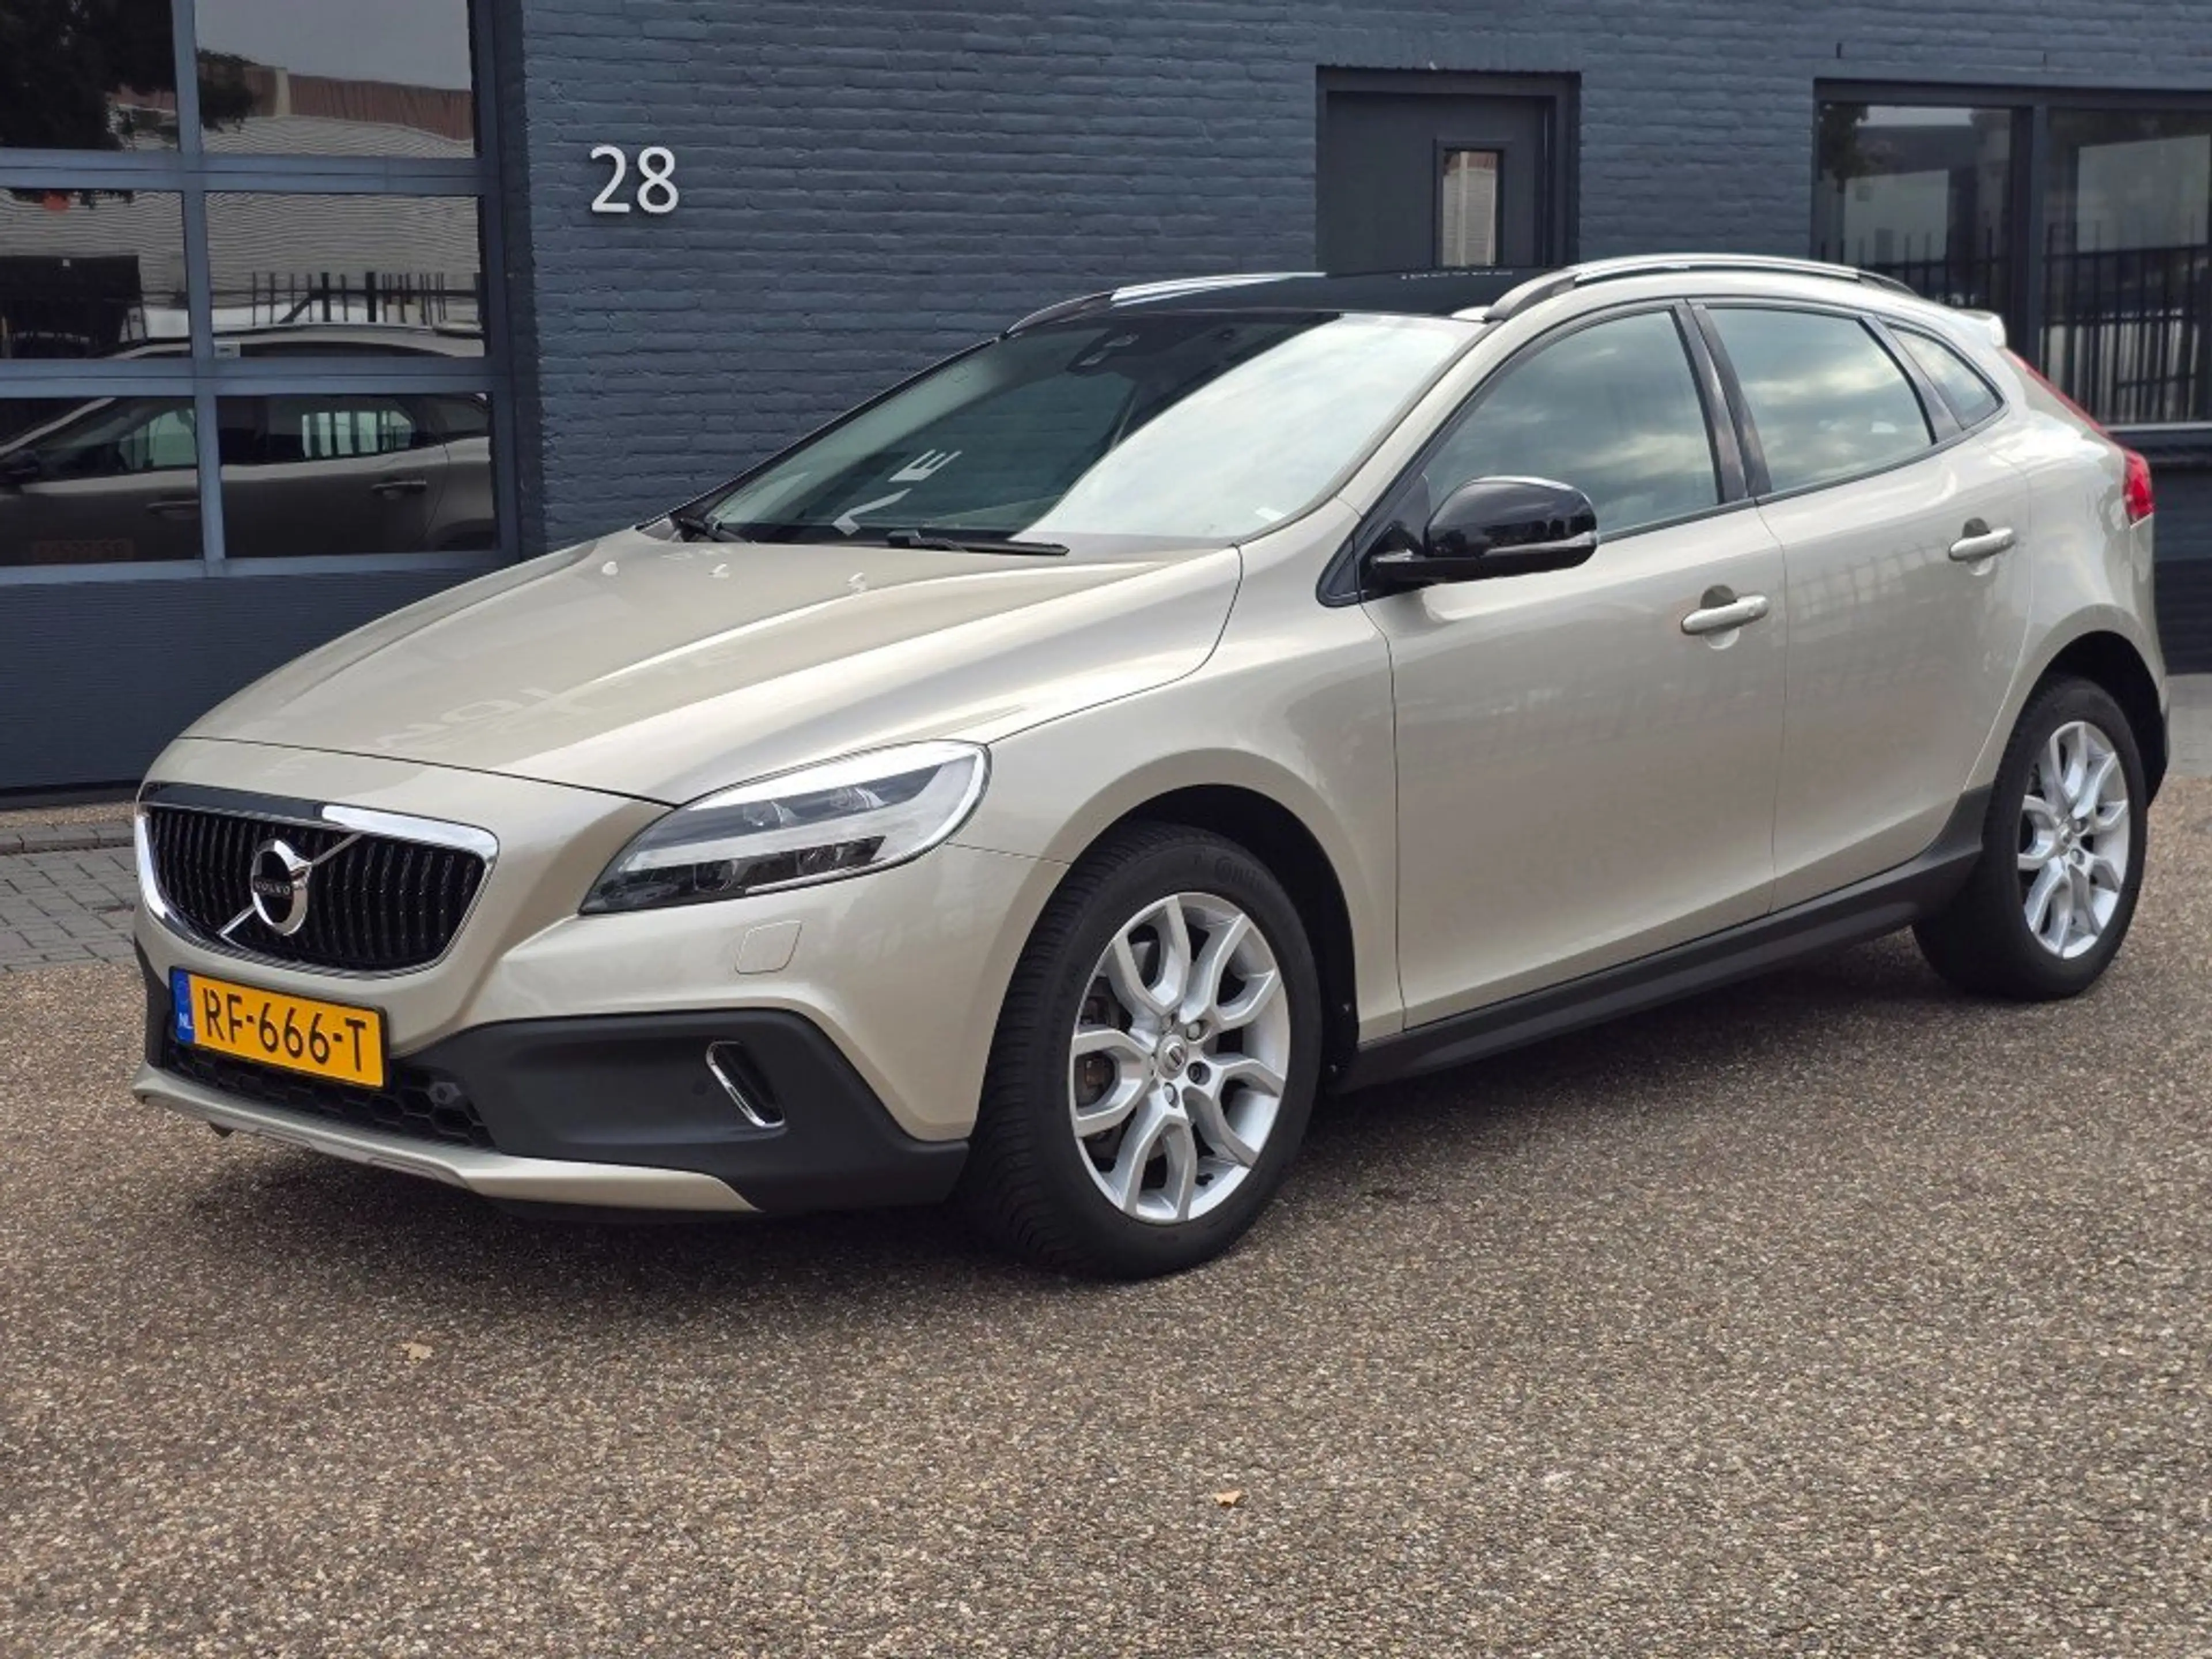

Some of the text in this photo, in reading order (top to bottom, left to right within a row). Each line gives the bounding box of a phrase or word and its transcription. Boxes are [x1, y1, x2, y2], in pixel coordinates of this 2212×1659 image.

[590, 145, 679, 213] 28
[254, 880, 291, 896] VOLVO
[179, 1012, 194, 1029] NL
[203, 987, 366, 1072] RF-666-T
